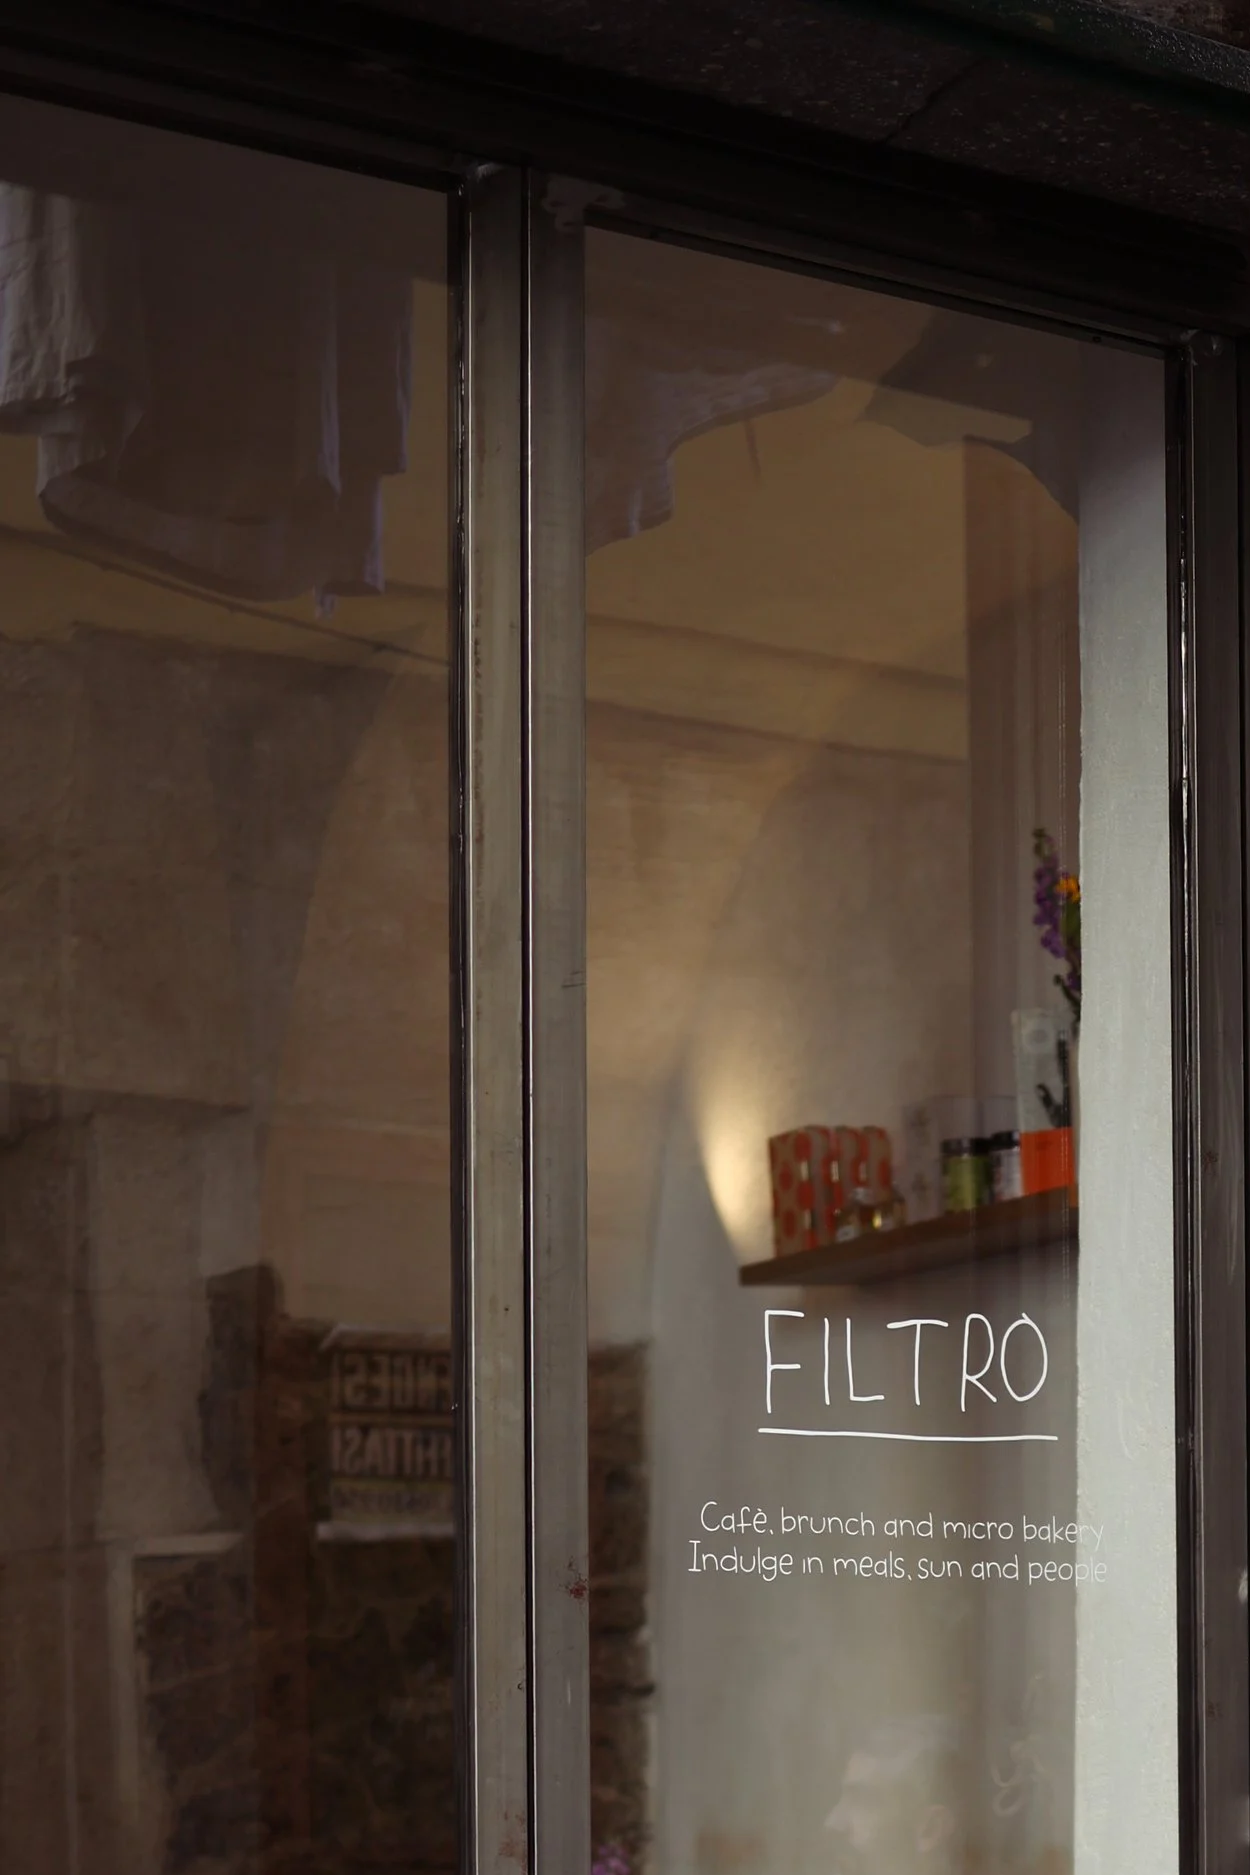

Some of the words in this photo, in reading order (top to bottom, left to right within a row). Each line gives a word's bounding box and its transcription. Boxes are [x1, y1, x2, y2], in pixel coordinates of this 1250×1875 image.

[765, 1309, 1048, 1414] FILTRO
[781, 1507, 876, 1537] brunch
[884, 1512, 933, 1538] and
[943, 1519, 1015, 1541] micro
[1023, 1515, 1104, 1551] bakery
[688, 1540, 794, 1582] Indulge
[802, 1557, 824, 1575] in
[834, 1551, 913, 1581] meals,
[918, 1557, 963, 1580] sun
[971, 1555, 1019, 1581] and
[1028, 1556, 1107, 1586] people
